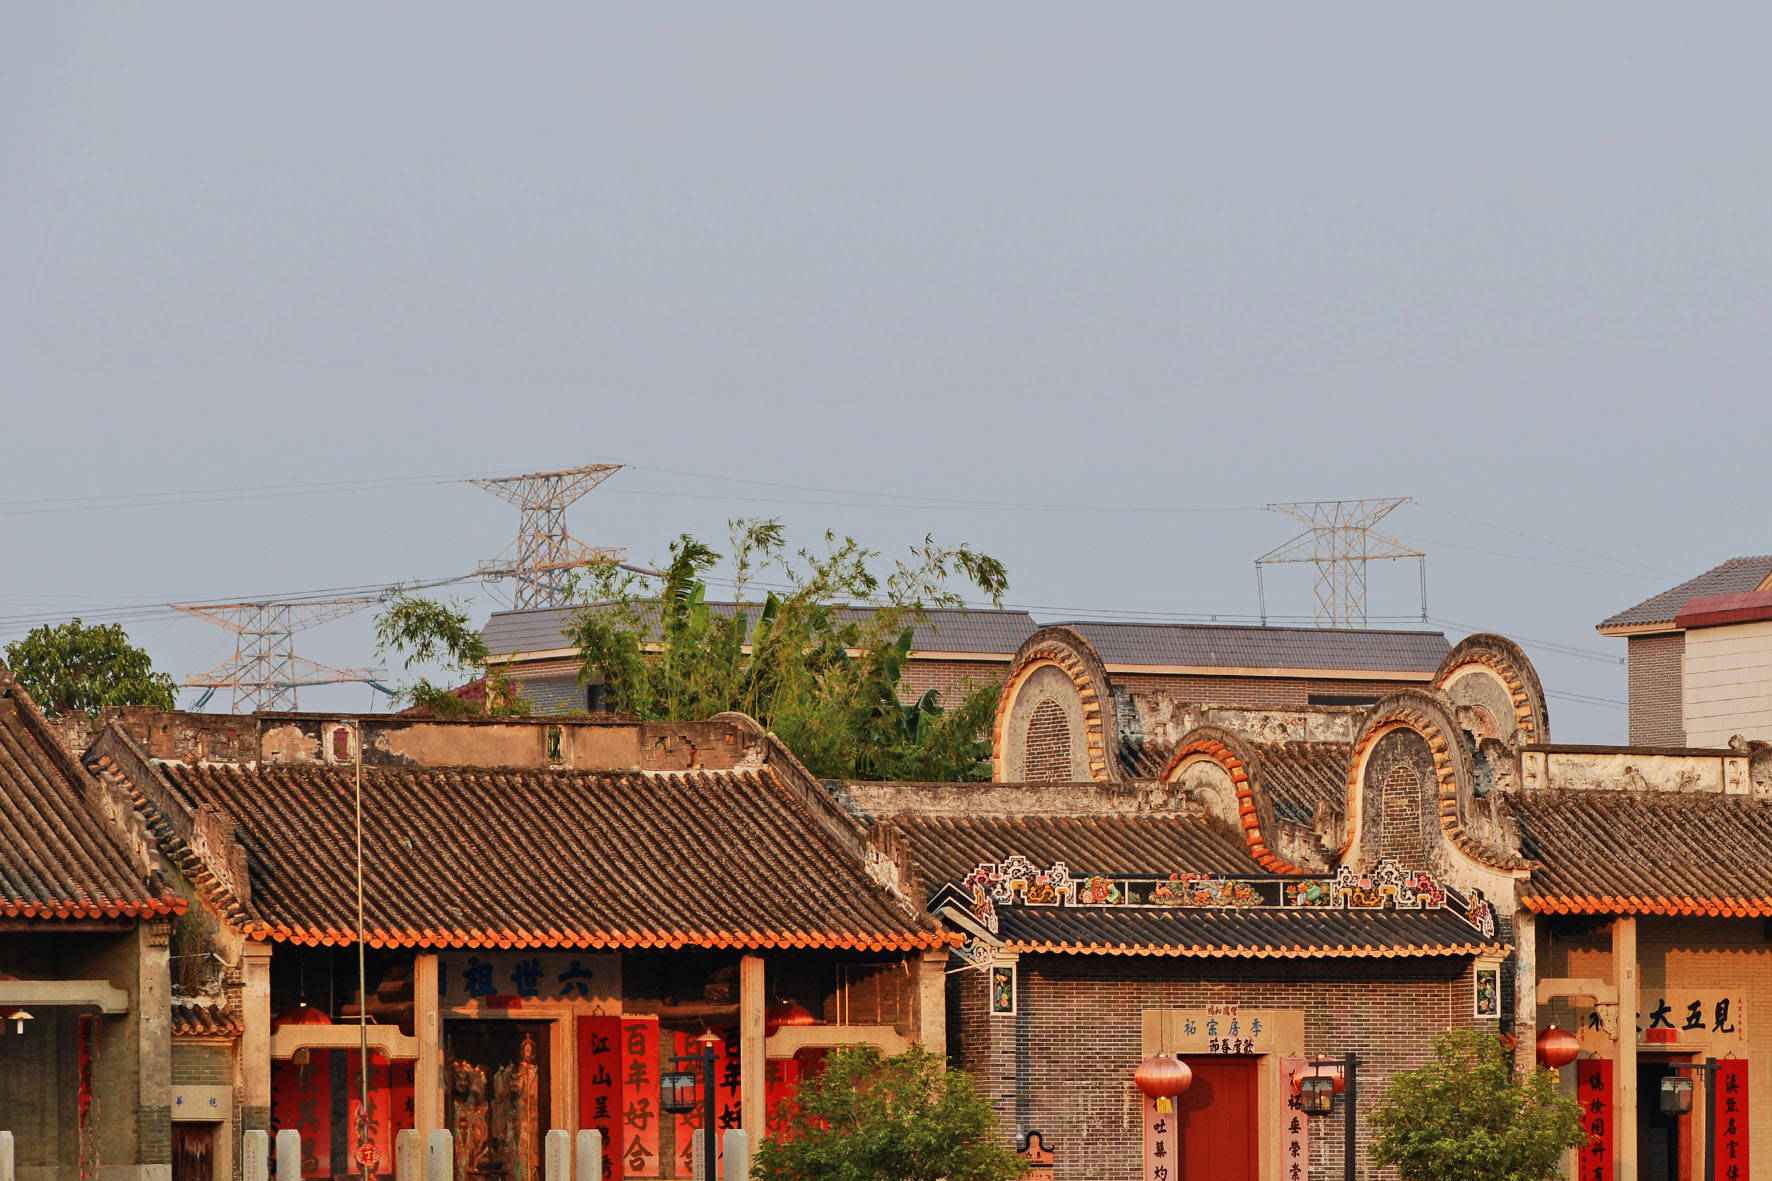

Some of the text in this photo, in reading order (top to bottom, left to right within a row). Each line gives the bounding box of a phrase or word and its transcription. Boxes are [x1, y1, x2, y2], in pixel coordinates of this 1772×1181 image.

[438, 956, 593, 997] 六世祖
[1588, 997, 1735, 1034] 見五大
[296, 1048, 320, 1174] 世其昌
[623, 1024, 655, 1172] 百年好合
